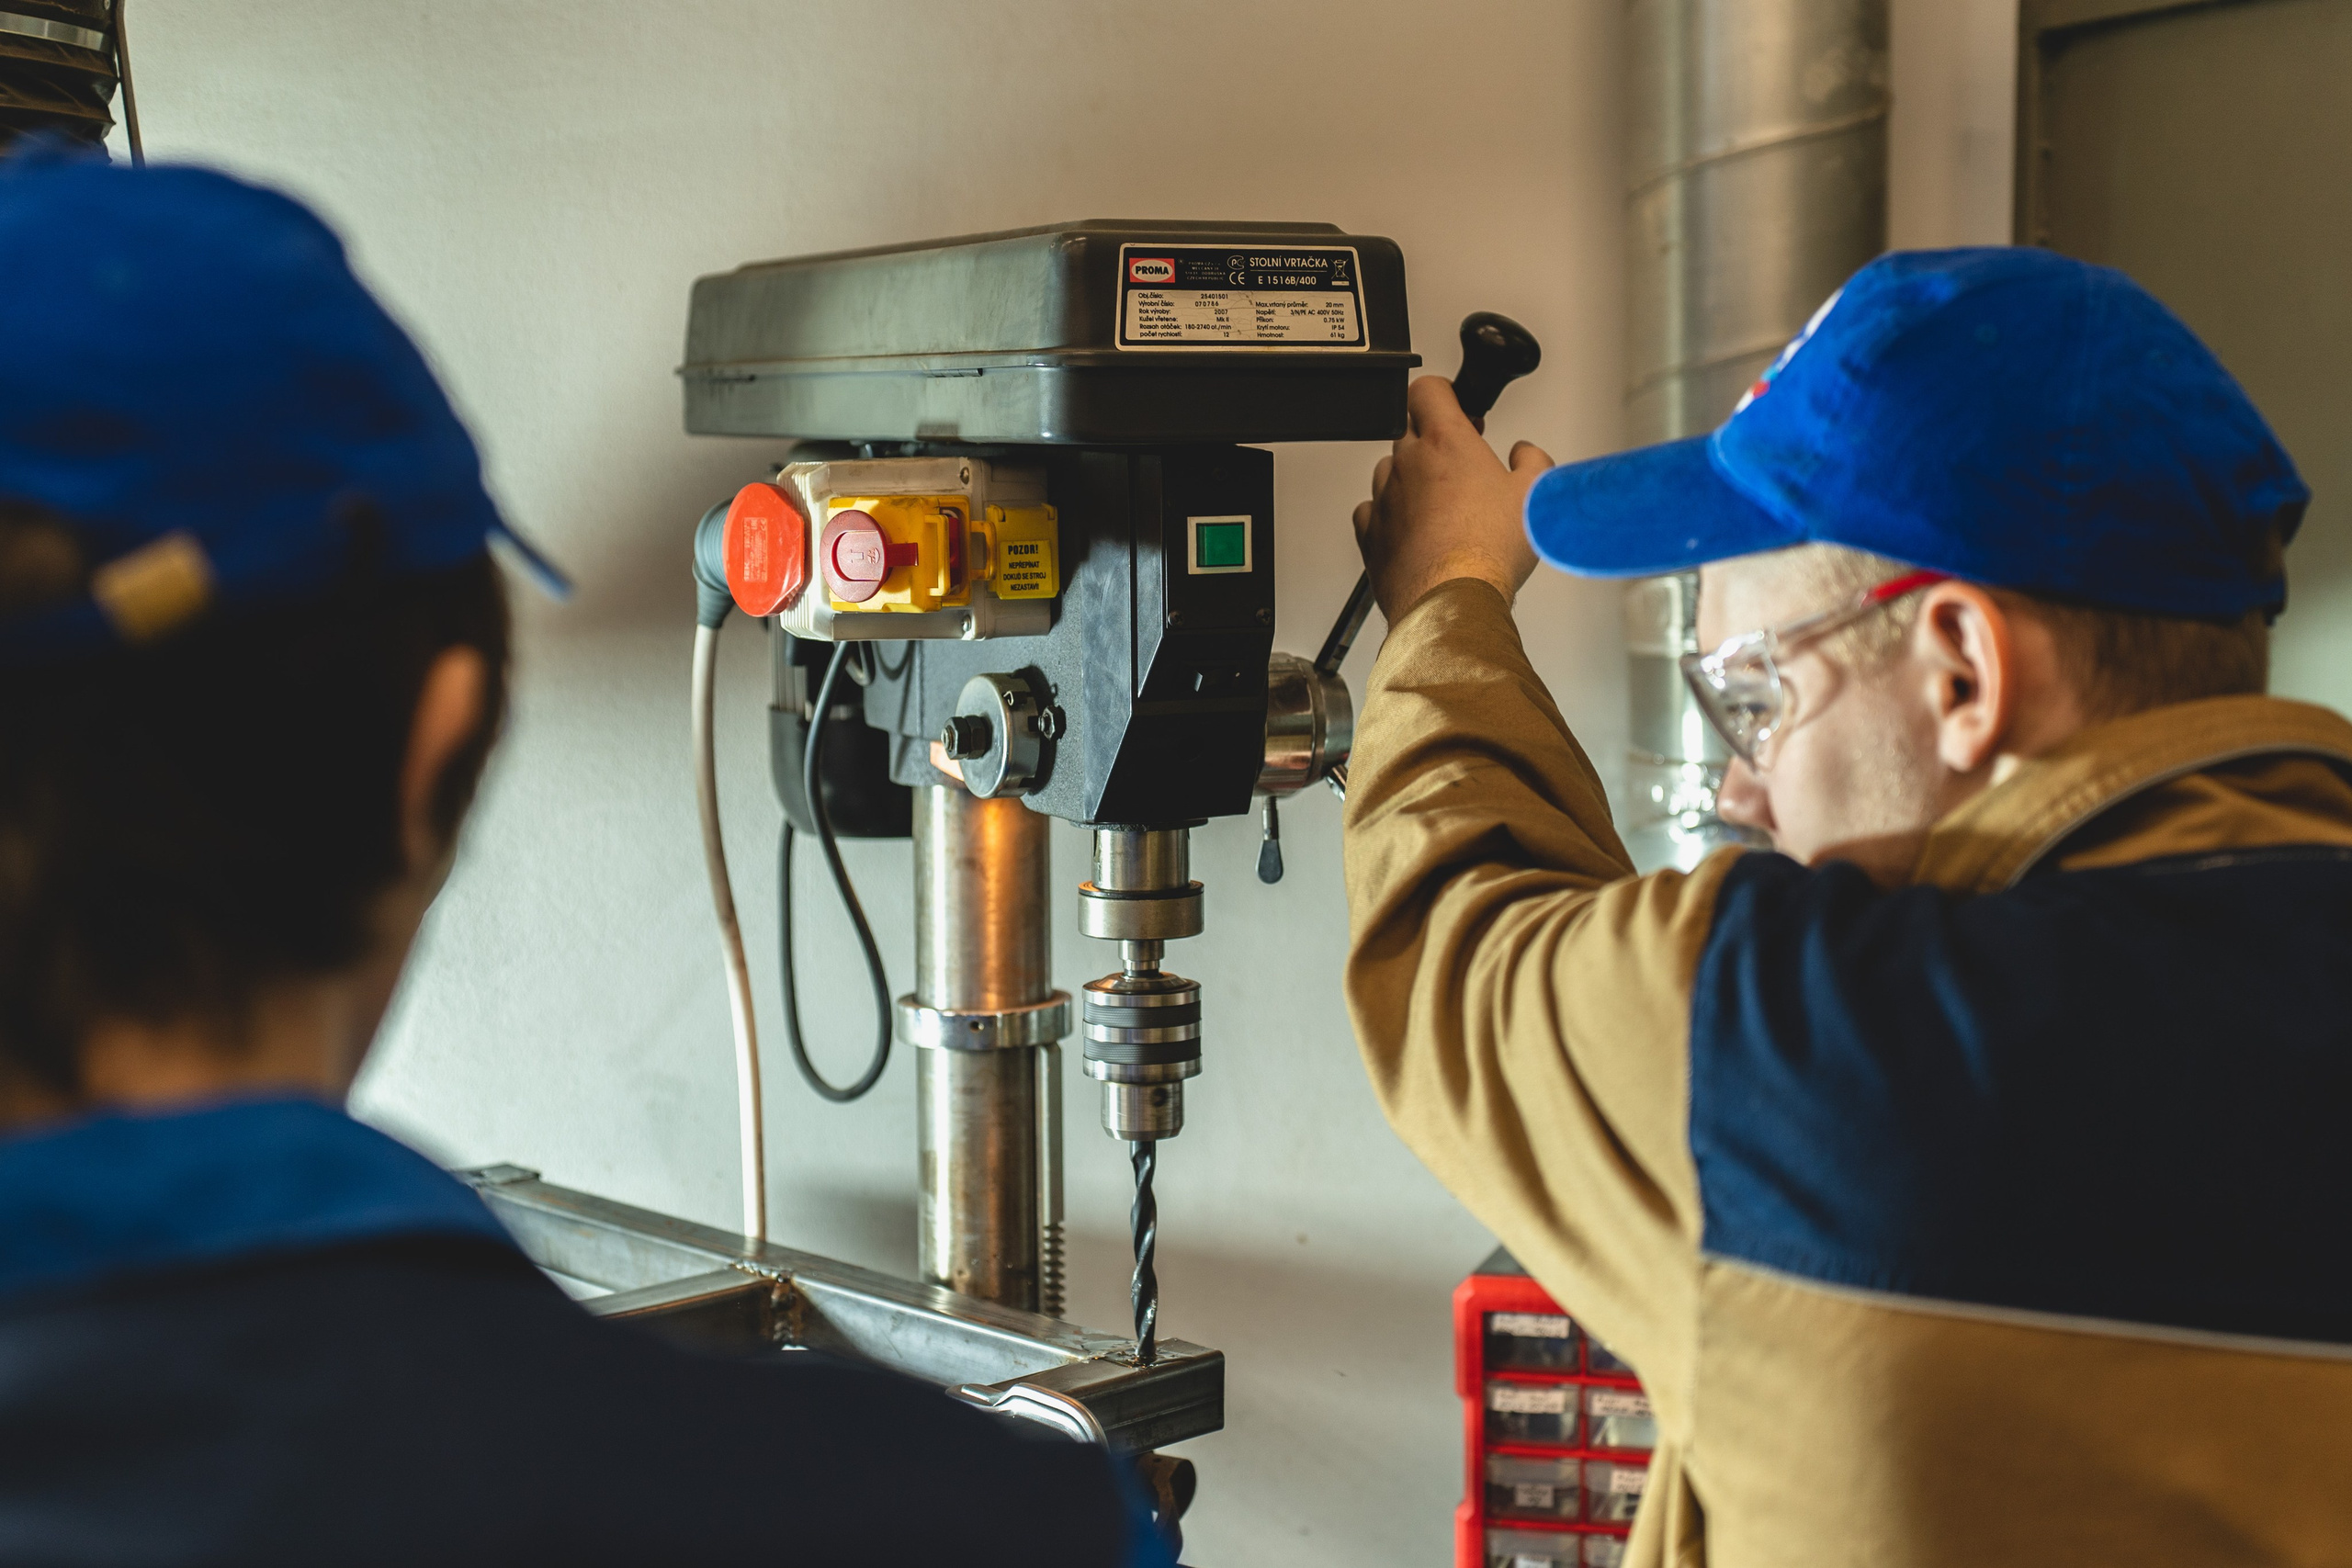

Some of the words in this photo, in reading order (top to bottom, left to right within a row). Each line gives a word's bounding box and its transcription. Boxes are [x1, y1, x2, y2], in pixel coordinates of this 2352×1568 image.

[1250, 255, 1282, 267] STOLNÍ
[1284, 255, 1329, 267] VRTAČKA
[1136, 265, 1170, 275] PROMA
[1259, 276, 1263, 285] E
[1268, 276, 1317, 287] 1516B/400
[1008, 545, 1038, 555] POZOR!
